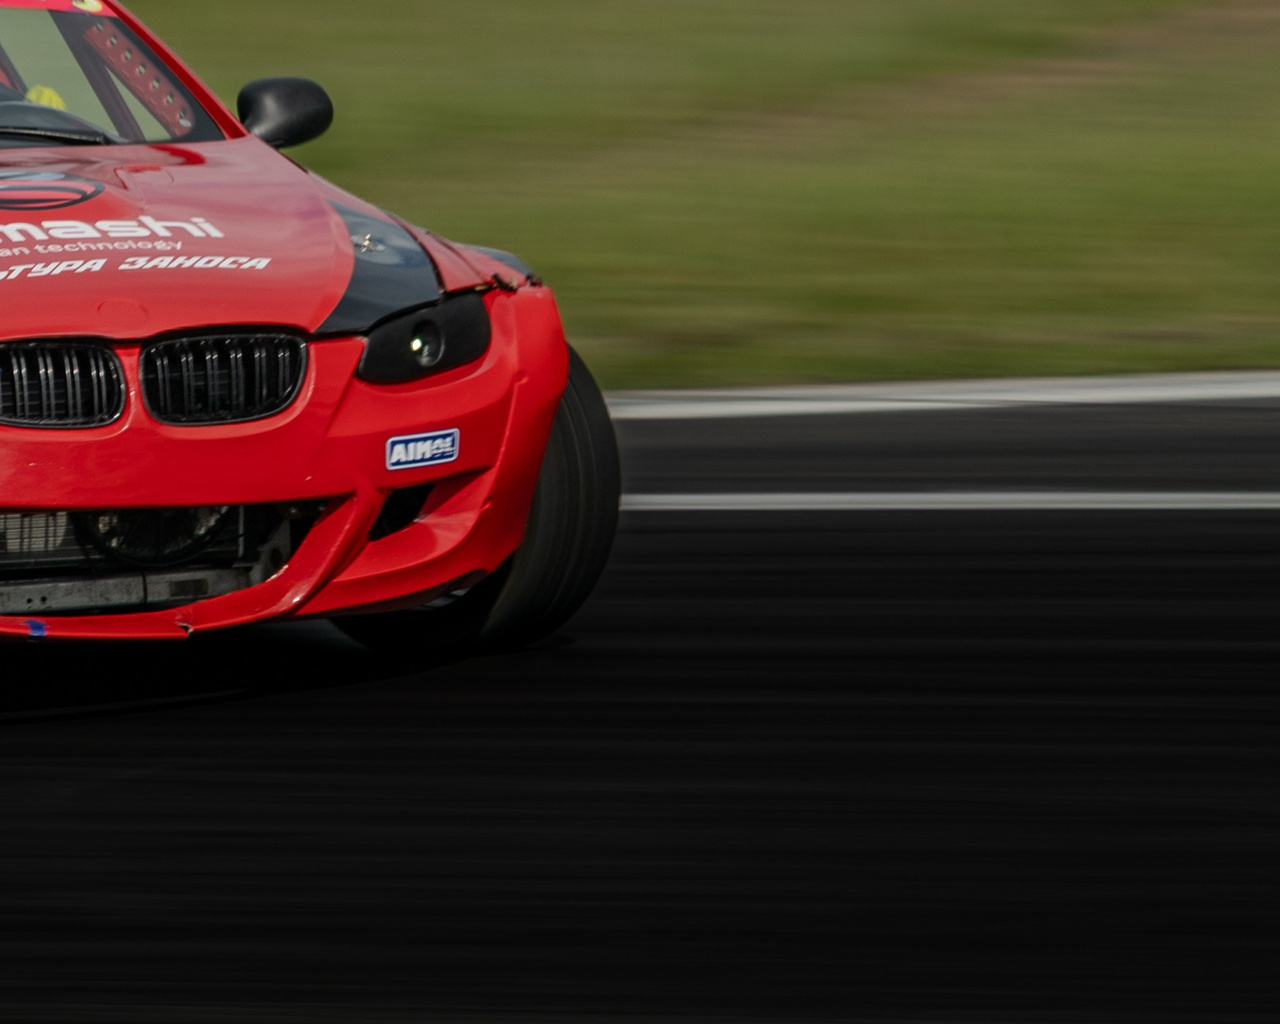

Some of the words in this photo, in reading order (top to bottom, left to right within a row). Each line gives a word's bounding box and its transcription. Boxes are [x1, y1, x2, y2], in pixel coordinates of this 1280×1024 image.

[34, 239, 183, 255] technology
[118, 255, 272, 271] ЗАНОСА
[390, 436, 456, 464] AIMOL
